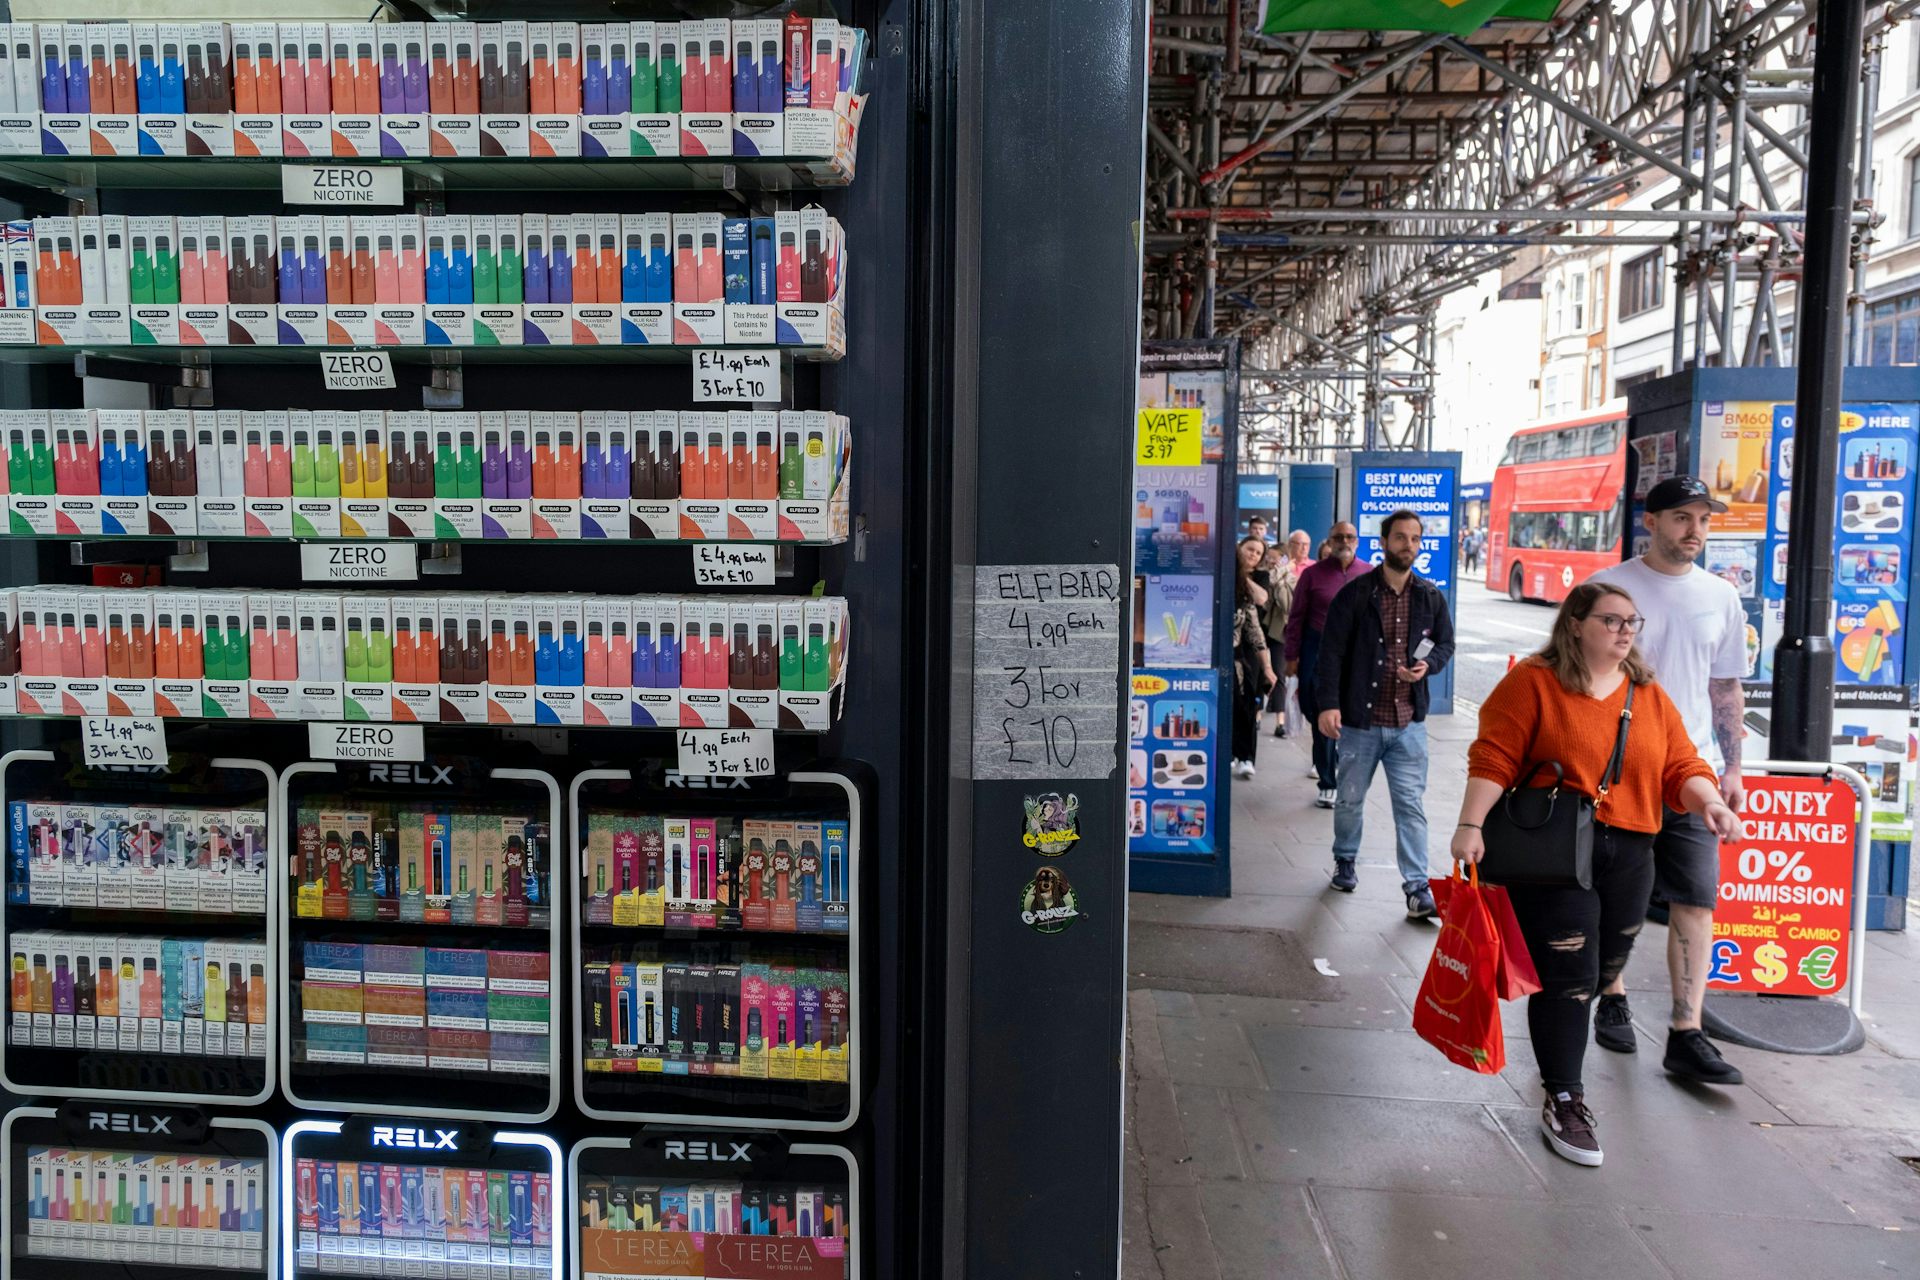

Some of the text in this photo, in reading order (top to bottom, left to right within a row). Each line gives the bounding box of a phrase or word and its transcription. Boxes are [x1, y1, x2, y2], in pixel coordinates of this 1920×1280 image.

[313, 170, 373, 188] ZERO
[313, 190, 373, 200] NICOTINE
[326, 356, 383, 373] ZERO
[744, 355, 770, 367] Each
[1140, 352, 1224, 363] epairs and Unlocking
[330, 376, 386, 387] NICOTINE
[700, 379, 711, 396] 3
[1142, 411, 1189, 433] VAPE
[1725, 413, 1773, 424] BM60
[1868, 416, 1910, 428] HERE
[1149, 434, 1176, 444] FROM
[1180, 472, 1208, 488] ME
[1365, 473, 1442, 485] BEST MONEY
[1370, 486, 1436, 498] EXCHANGE
[1362, 501, 1449, 512] 0% COMMISSION
[1420, 539, 1440, 550] ATE
[329, 547, 386, 564] ZERO
[743, 552, 766, 563] Each
[330, 568, 388, 577] NICOTINE
[699, 569, 709, 582] 3
[998, 570, 1116, 602] ELF BAR
[1008, 608, 1104, 649] 4.99 Each
[1004, 666, 1080, 708] 3 For
[1134, 680, 1210, 691] ALE HERE
[1841, 691, 1858, 700] and
[1859, 691, 1903, 702] Unlocking
[133, 721, 156, 732] Each
[336, 727, 393, 744] ZERO
[681, 731, 750, 756] 4.99 Each
[1002, 715, 1077, 768] £10
[90, 745, 100, 759] 3
[101, 745, 118, 758] For
[336, 747, 394, 757] NICOTINE
[708, 757, 769, 773] 3 For £10
[369, 763, 454, 785] RELX
[665, 769, 751, 789] RELX
[1741, 820, 1847, 844] CHANGE
[1738, 848, 1812, 883] 0%
[1717, 882, 1844, 906] OMMISSION
[1752, 905, 1802, 925] صرافة
[1712, 922, 1841, 942] ELD WESCHEL CAMBIO
[314, 945, 350, 958] TEREA
[437, 952, 474, 962] TEREA
[501, 956, 537, 966] TEREA
[1706, 938, 1839, 990] £ $ €
[440, 994, 475, 1005] TEREA
[379, 1030, 416, 1041] TEREA
[89, 1112, 172, 1134] RELX
[373, 1126, 458, 1150] RELX
[665, 1141, 752, 1161] RELX
[613, 1237, 688, 1257] TEREA
[735, 1242, 812, 1263] TEREA
